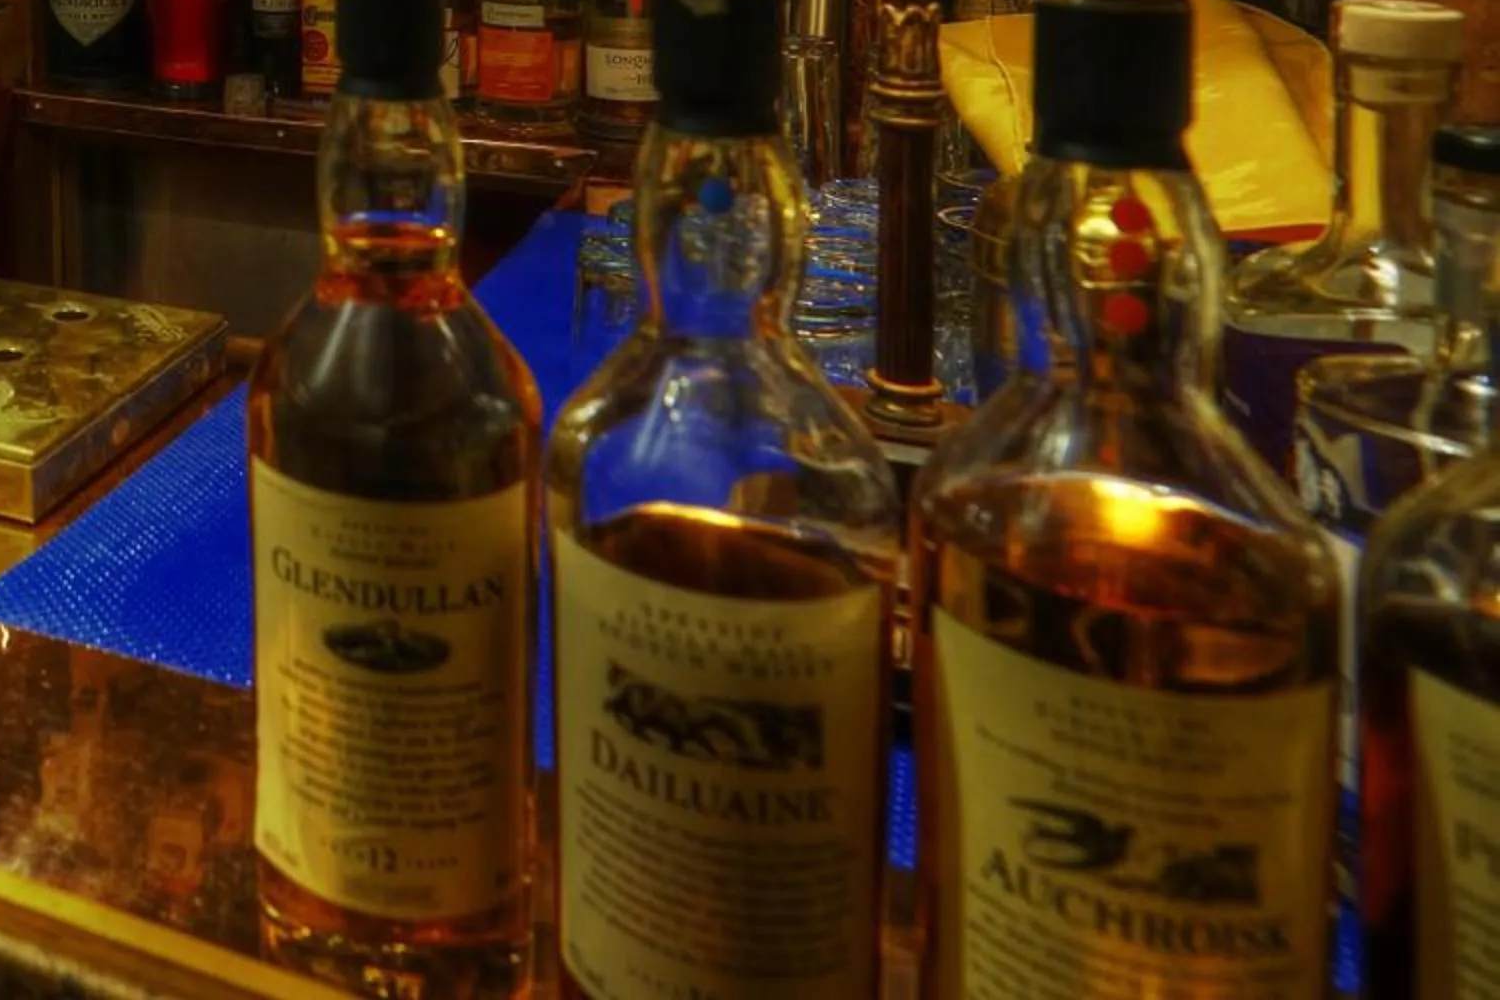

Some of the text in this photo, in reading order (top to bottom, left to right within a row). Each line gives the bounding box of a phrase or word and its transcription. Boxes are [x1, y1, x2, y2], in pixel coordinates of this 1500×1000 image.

[272, 546, 507, 614] GLENDULLAN
[590, 730, 834, 826] DAILUAINE
[981, 848, 1294, 955] AUCHROISK
